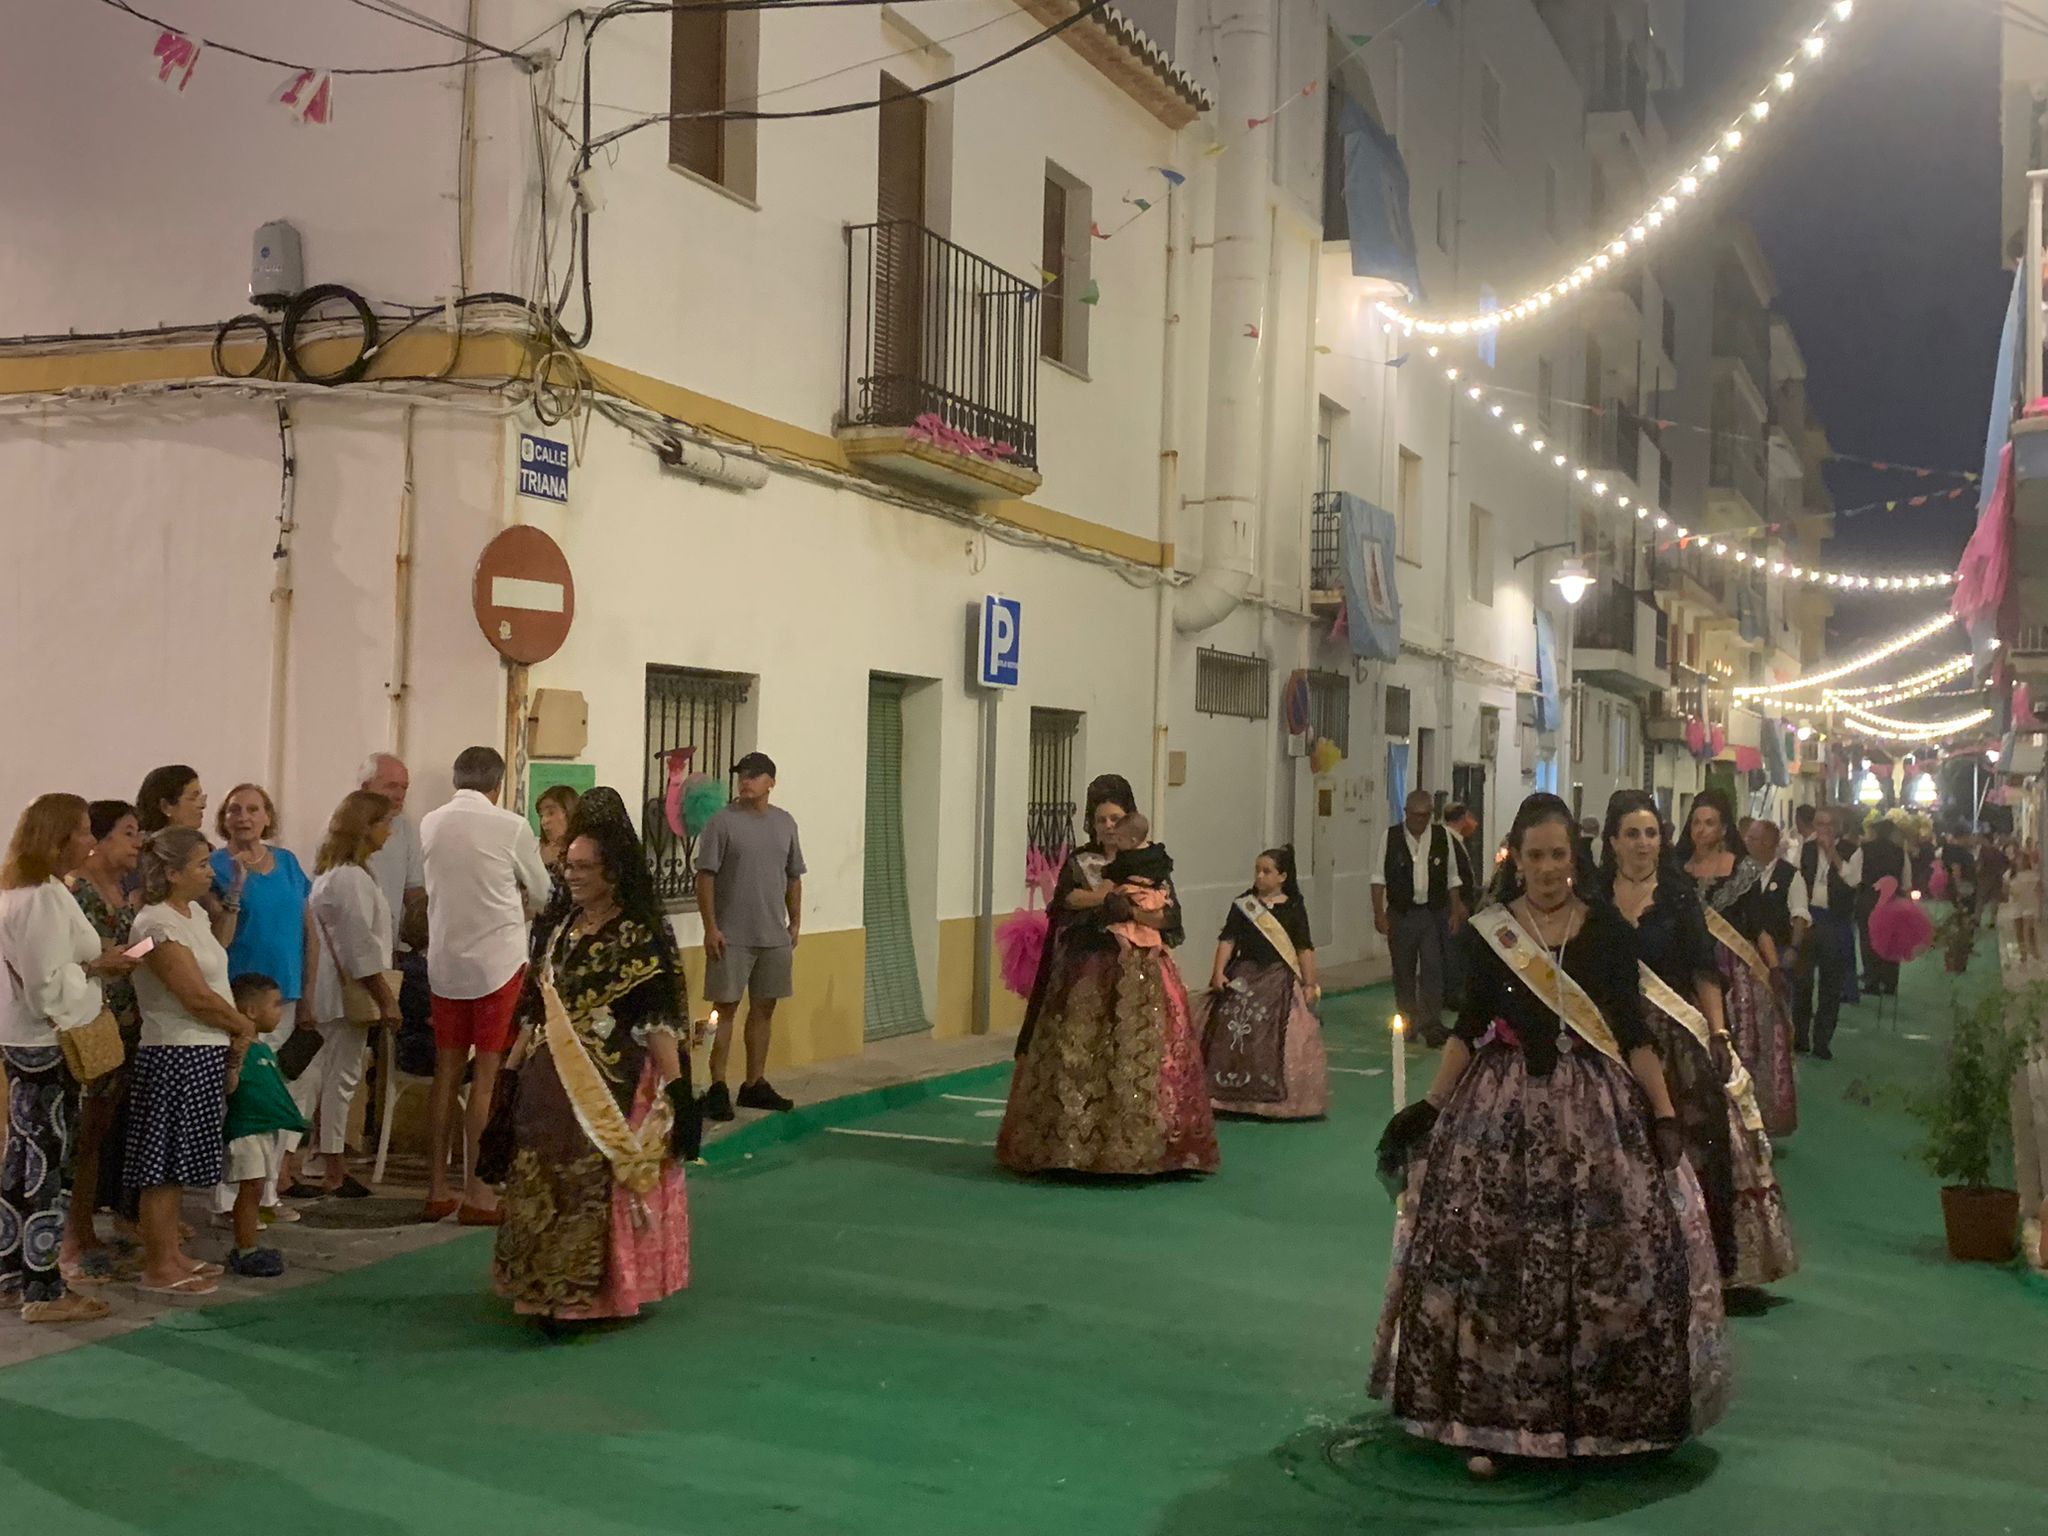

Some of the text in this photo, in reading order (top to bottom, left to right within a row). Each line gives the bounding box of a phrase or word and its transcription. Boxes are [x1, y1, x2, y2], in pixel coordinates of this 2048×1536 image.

[535, 445, 567, 467] CALLE
[521, 469, 567, 499] TRIANA
[990, 604, 1014, 675] P
